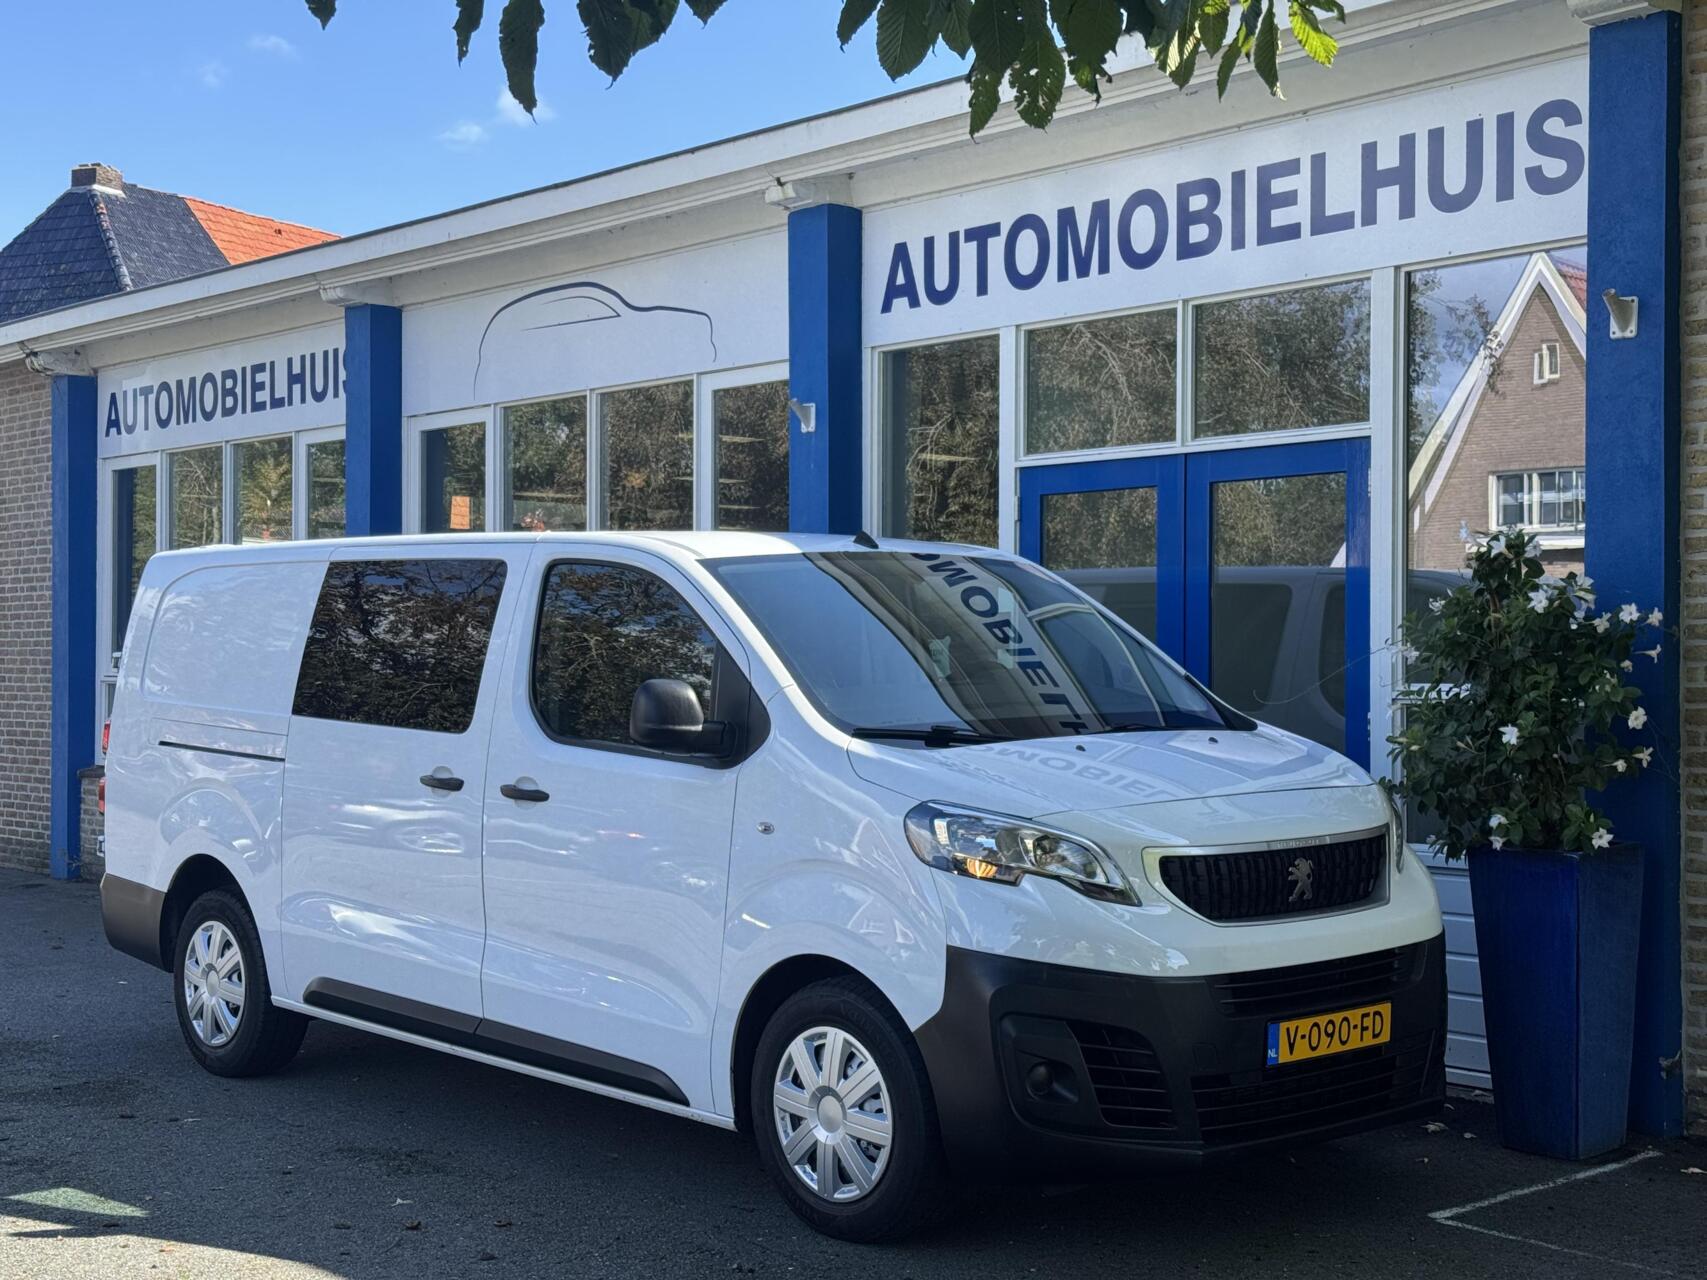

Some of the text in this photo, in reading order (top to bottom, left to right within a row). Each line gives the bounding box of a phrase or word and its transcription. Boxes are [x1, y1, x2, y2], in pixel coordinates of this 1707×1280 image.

[880, 99, 1585, 314] AUTOMOBIELHUIS
[105, 348, 346, 437] AUTOMOBIELHUI
[1267, 1048, 1278, 1058] NL
[1286, 1010, 1384, 1056] V-090-FD
